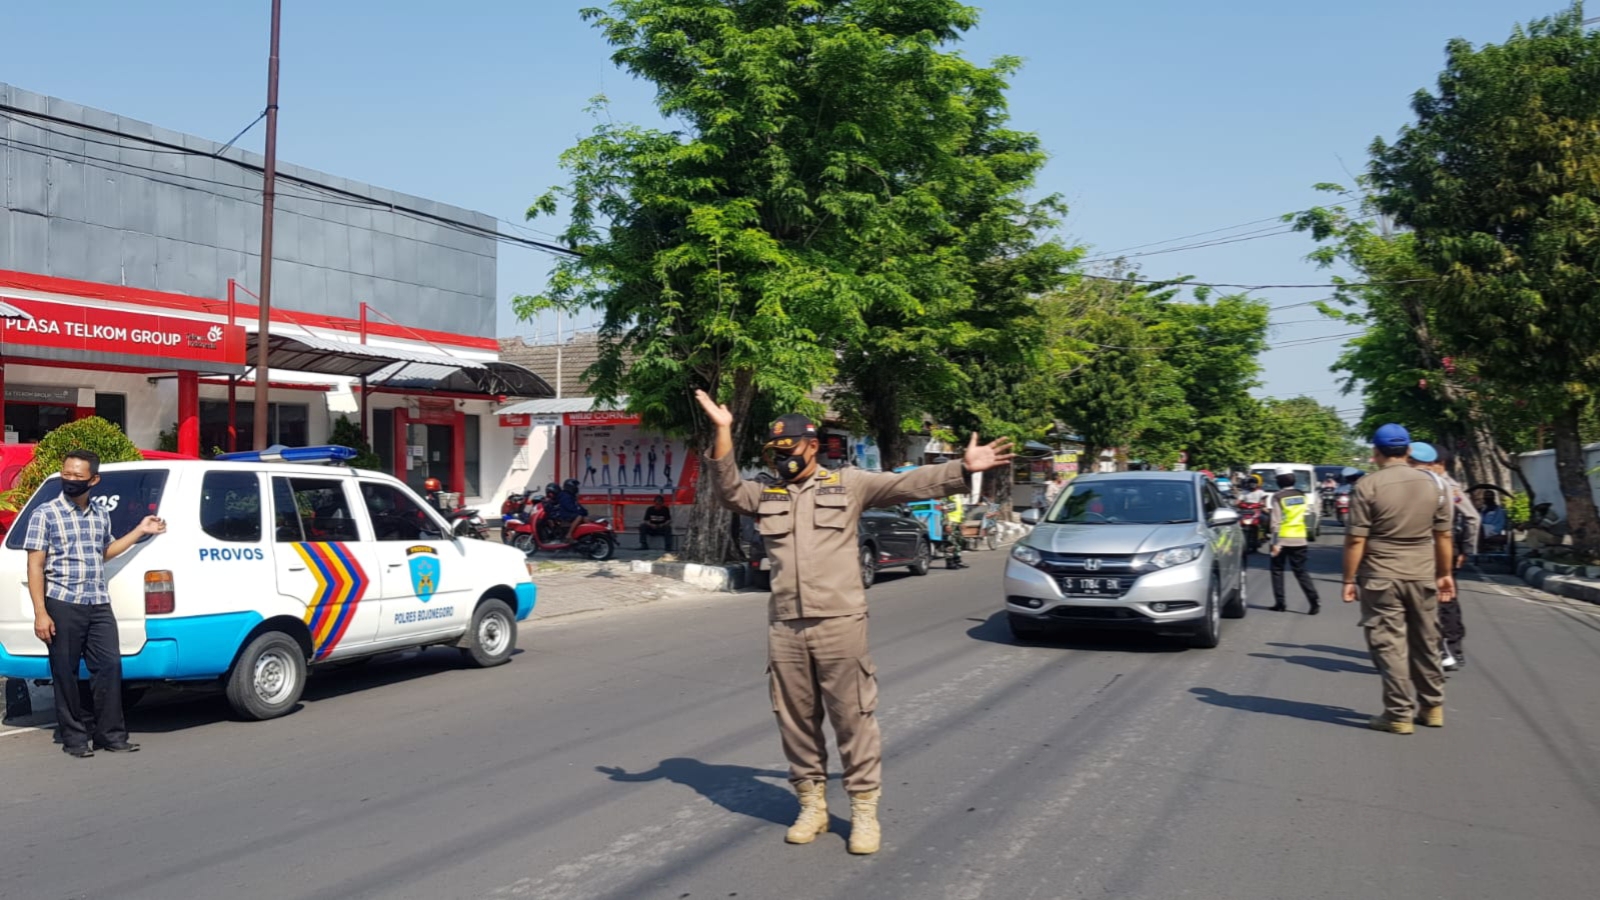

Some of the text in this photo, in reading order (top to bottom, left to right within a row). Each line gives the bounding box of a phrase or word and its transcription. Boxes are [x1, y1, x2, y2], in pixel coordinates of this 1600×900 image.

[5, 318, 181, 346] PLASA TELKOM GROUP
[199, 548, 264, 561] PROVOS
[394, 606, 454, 624] POLRES BOJONEGORO
